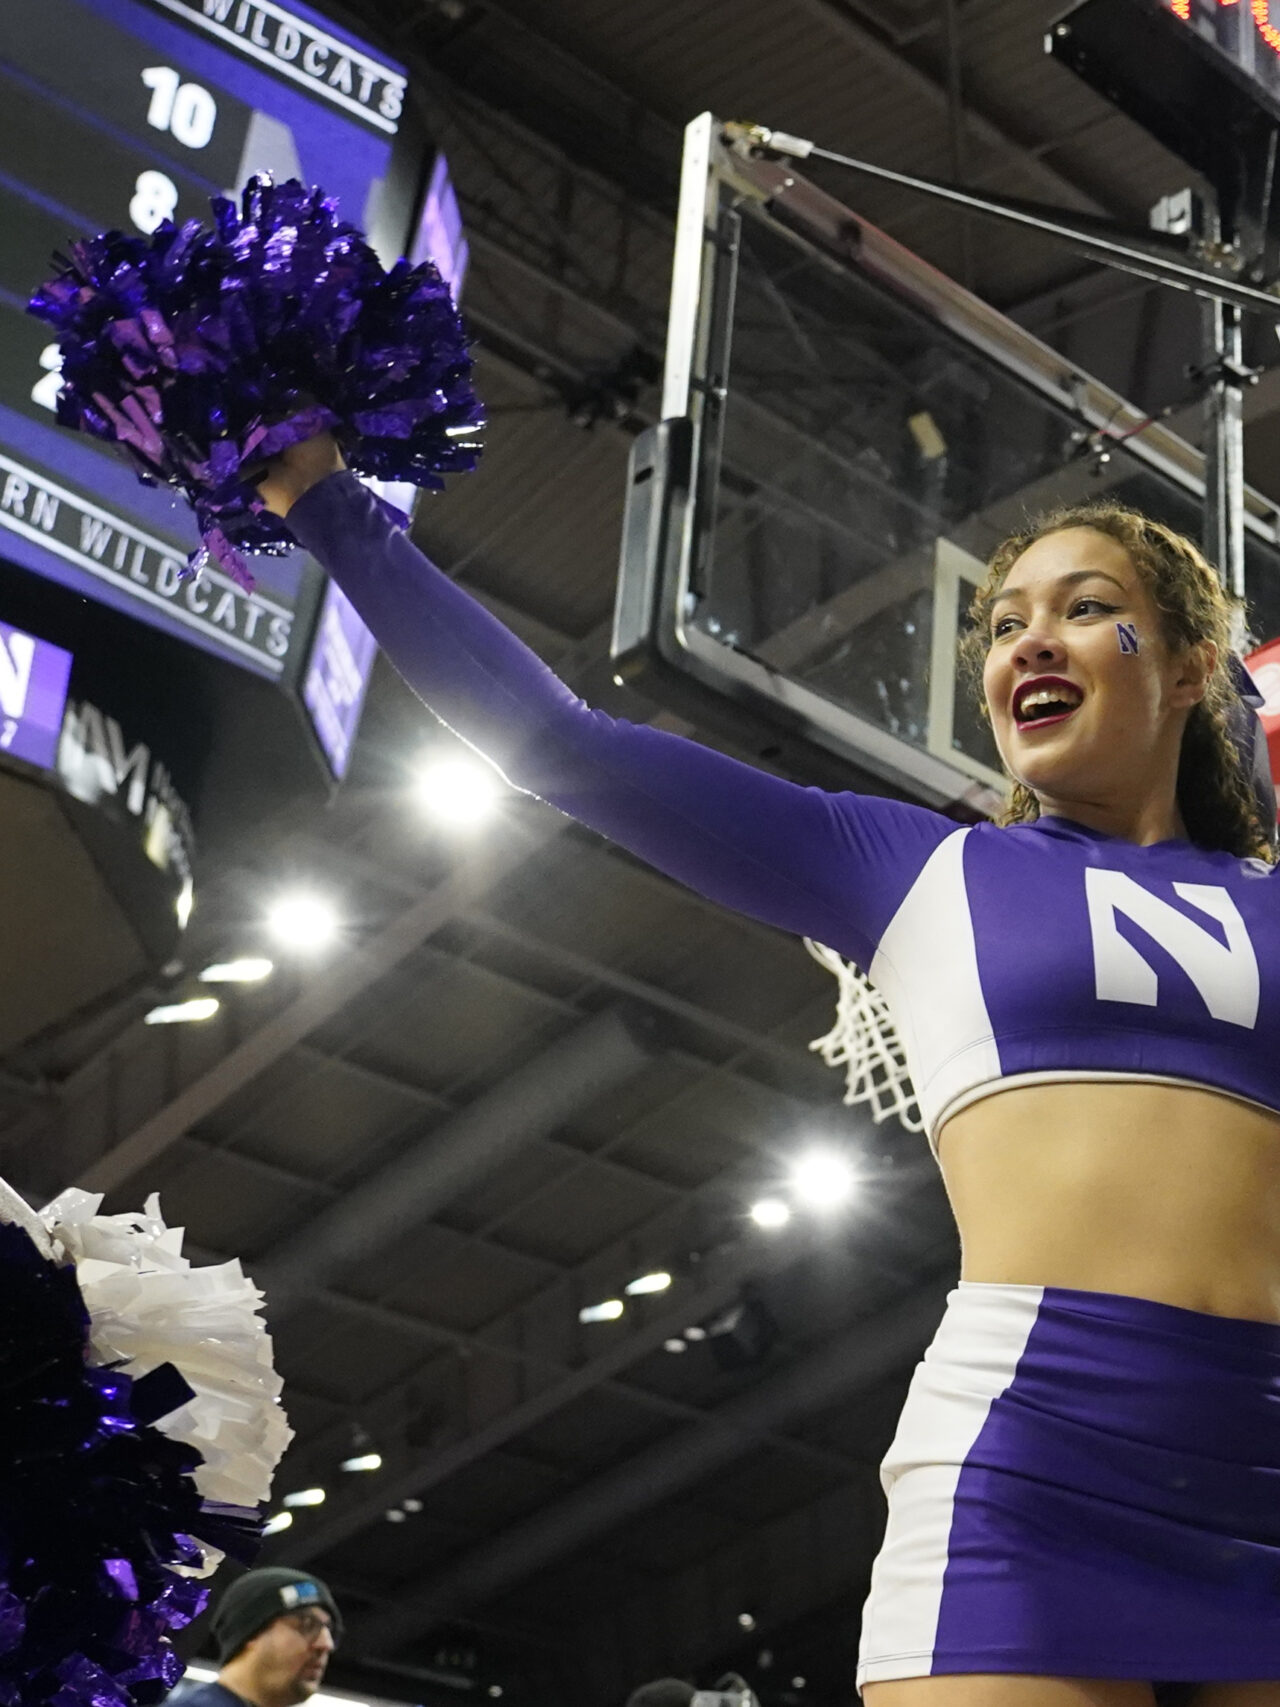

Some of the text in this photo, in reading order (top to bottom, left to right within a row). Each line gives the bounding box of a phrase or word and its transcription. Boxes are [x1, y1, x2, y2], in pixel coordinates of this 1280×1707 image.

[141, 66, 217, 149] 10
[203, 0, 405, 120] WILDCATS
[79, 514, 293, 657] WILDCATS
[1116, 621, 1140, 657] N
[1085, 866, 1261, 1030] N
